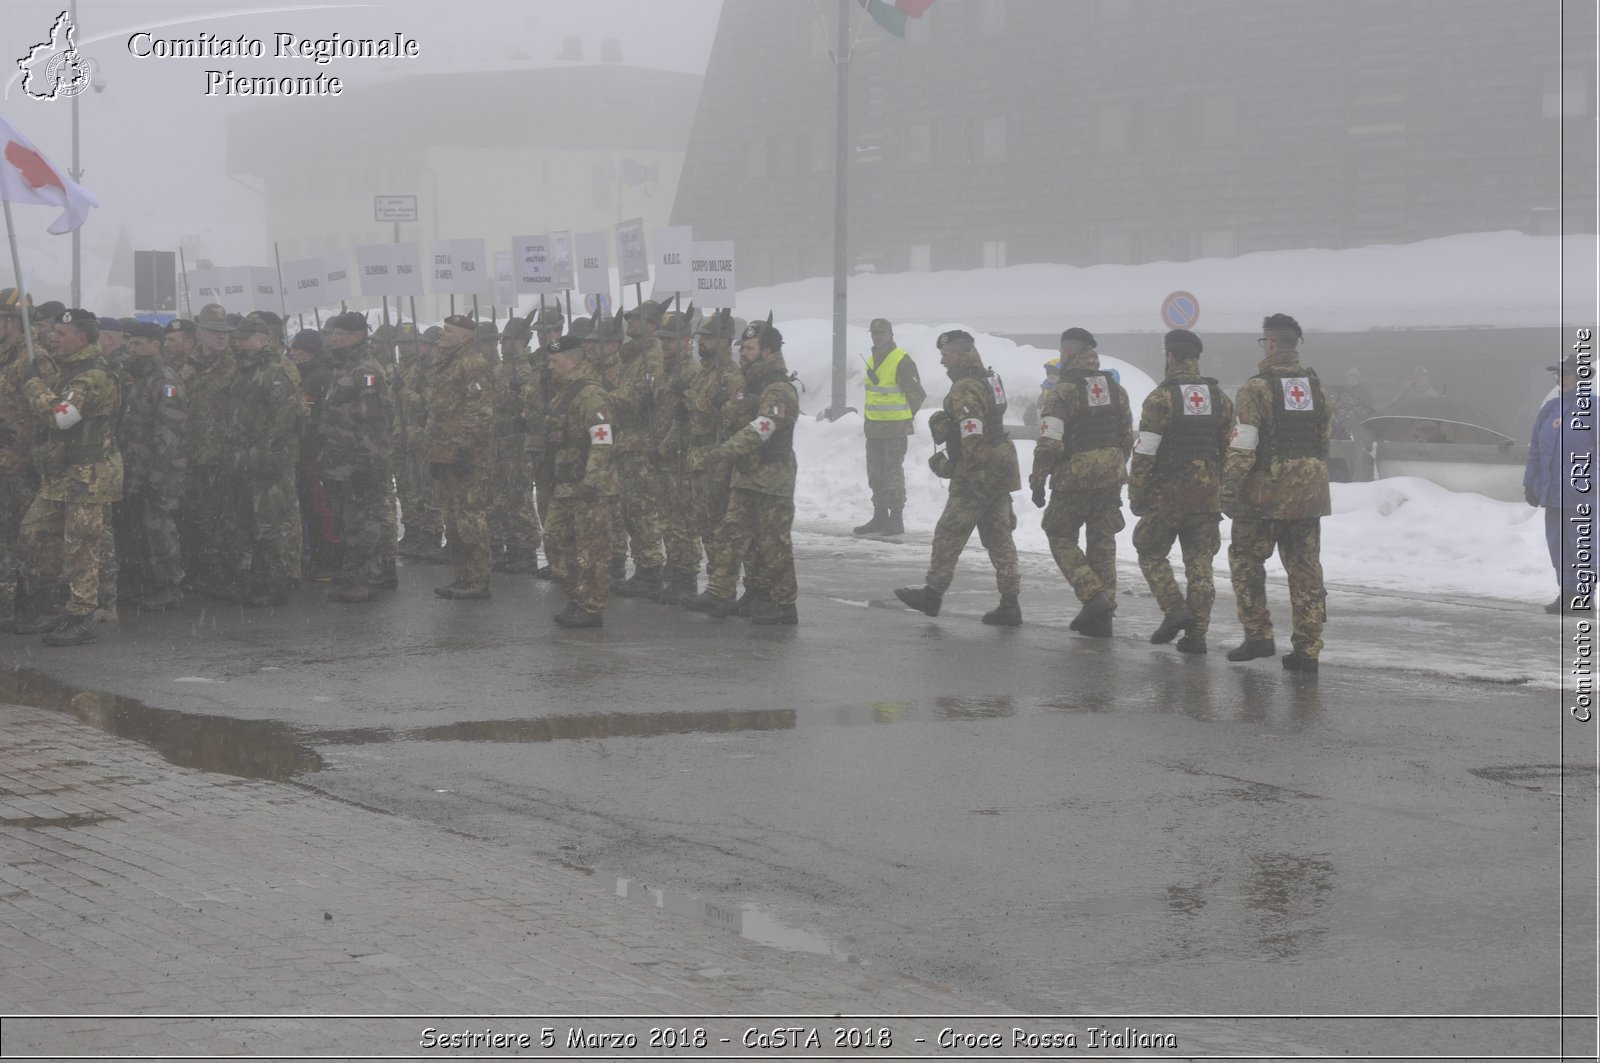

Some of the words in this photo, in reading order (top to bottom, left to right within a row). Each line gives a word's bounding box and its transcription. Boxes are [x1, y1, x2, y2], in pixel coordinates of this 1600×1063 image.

[434, 254, 447, 265] STATI
[691, 259, 709, 272] CORPO
[709, 259, 733, 272] MILITARE
[364, 264, 389, 276] SLOVENIA
[396, 264, 413, 275] SPAGNA
[460, 261, 476, 272] ITALIA
[297, 277, 319, 289] LIBANO
[697, 277, 713, 290] DELLA
[713, 277, 728, 290] C.R.I.
